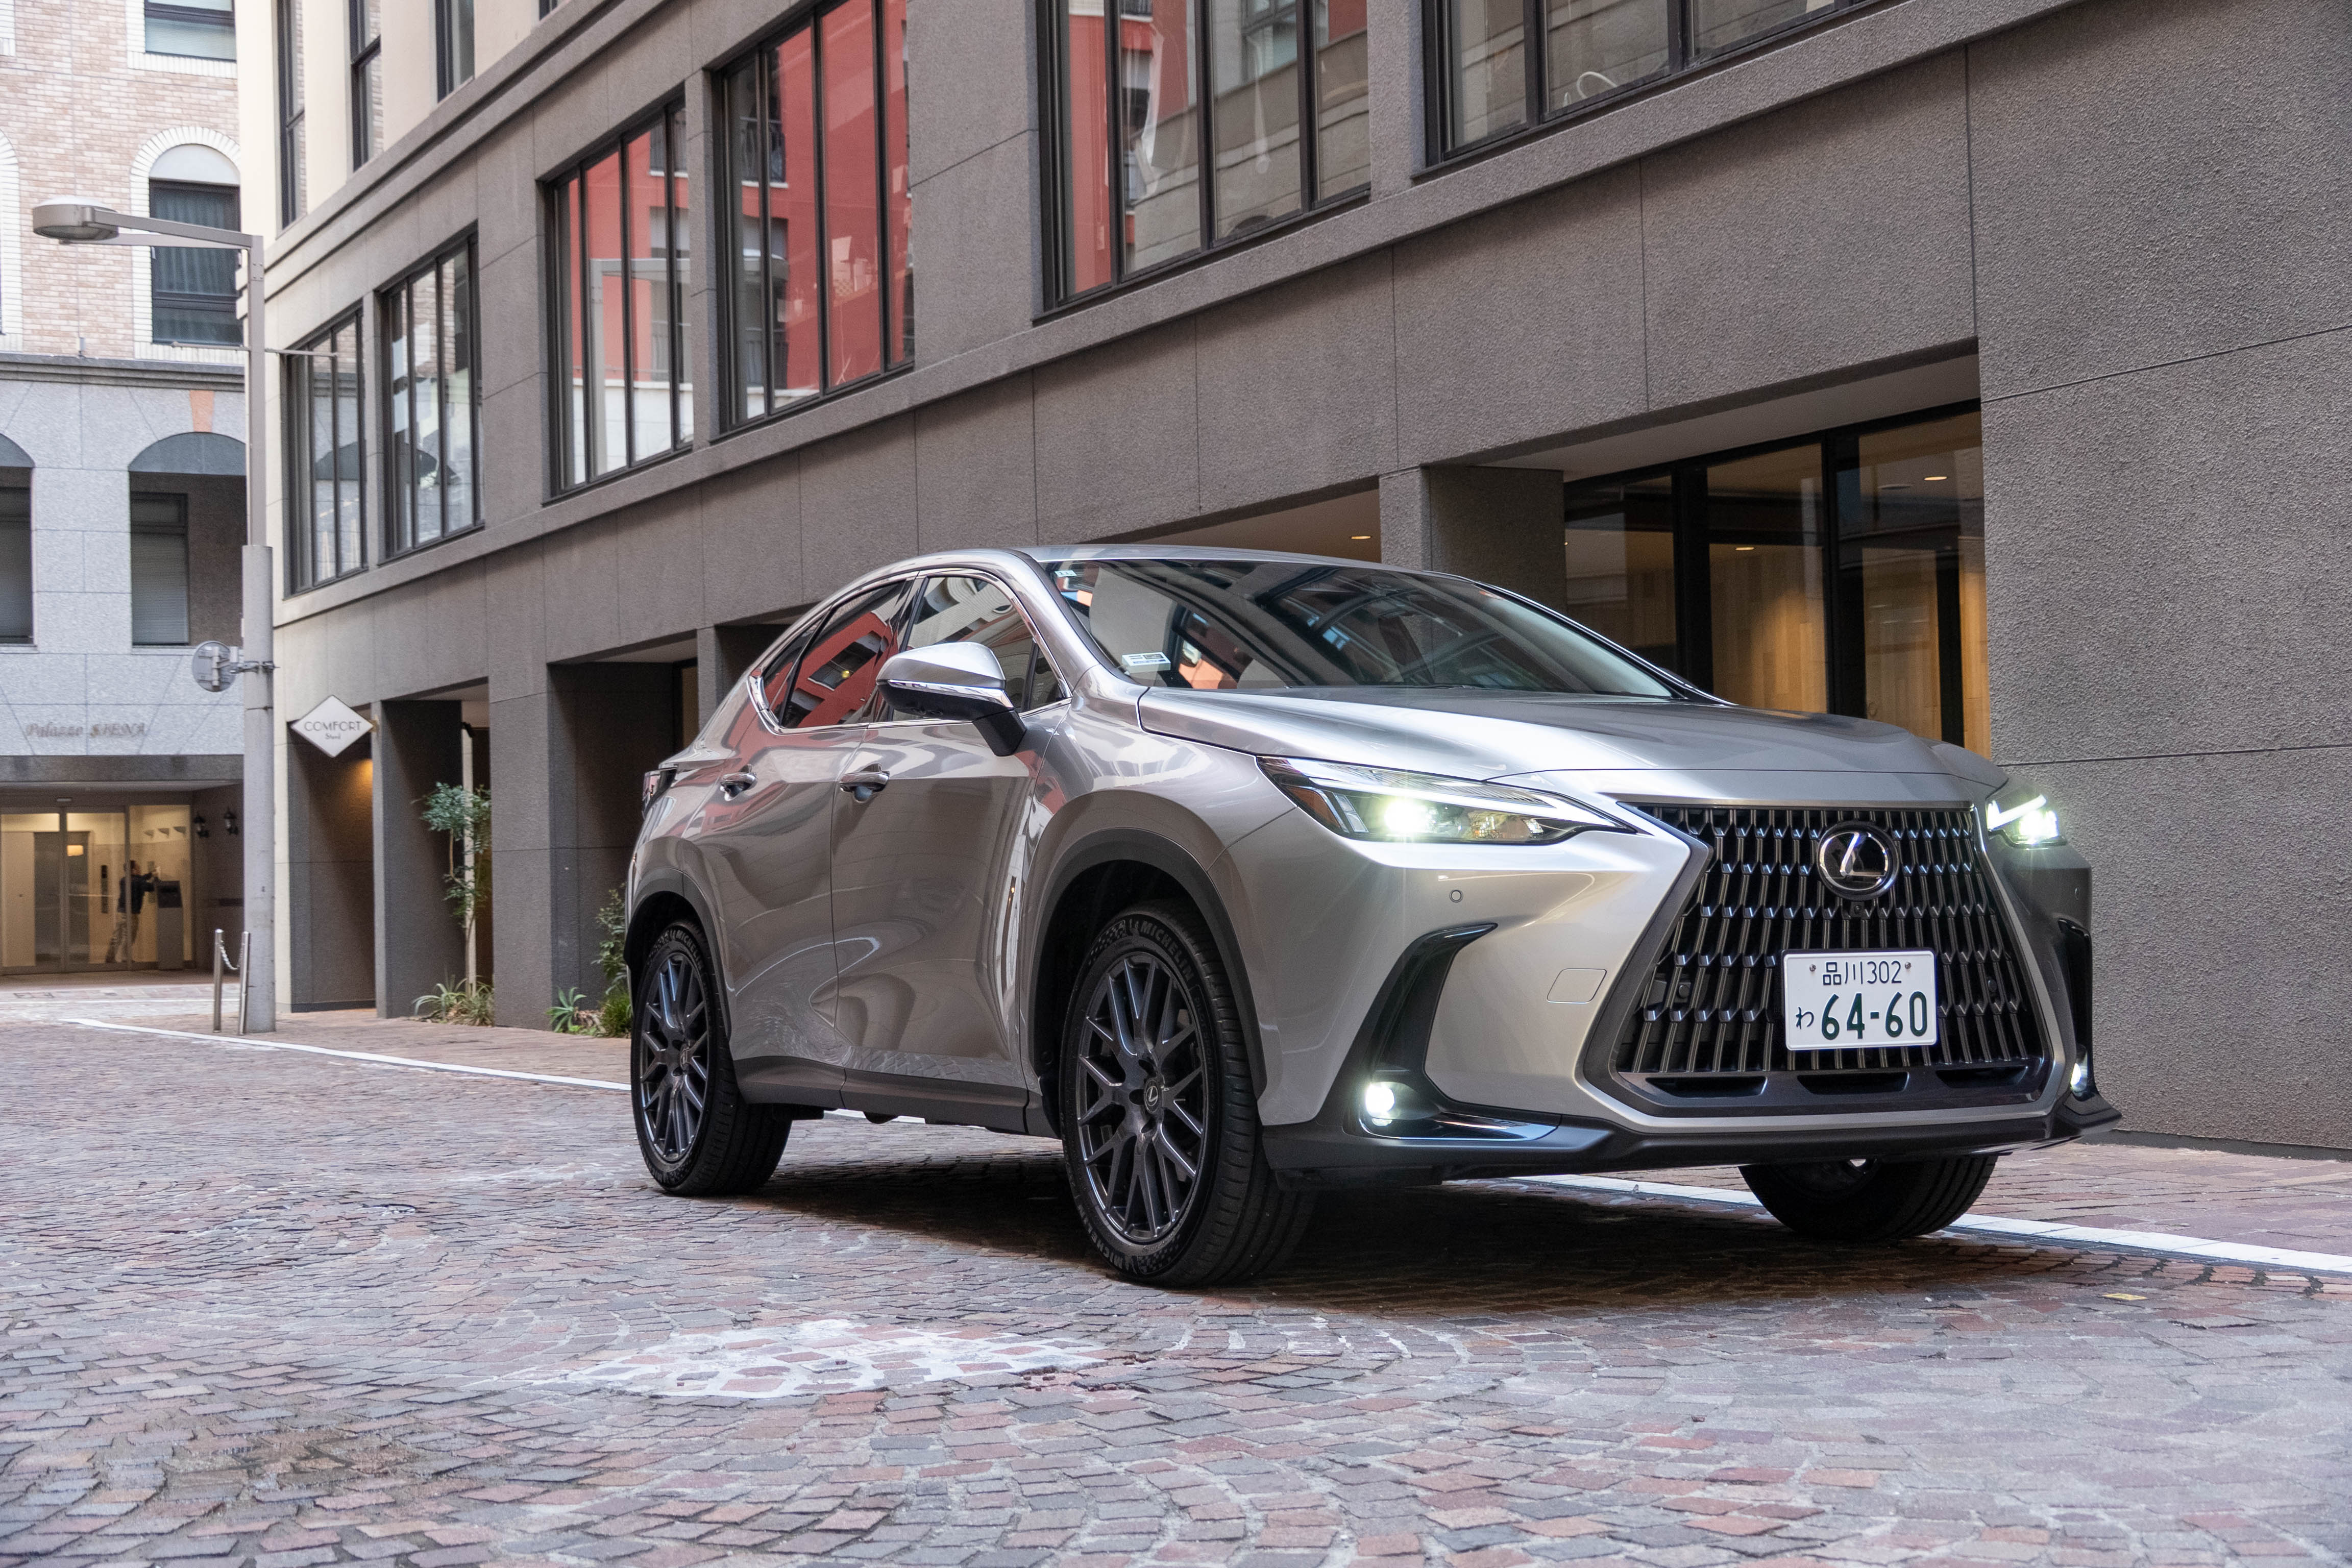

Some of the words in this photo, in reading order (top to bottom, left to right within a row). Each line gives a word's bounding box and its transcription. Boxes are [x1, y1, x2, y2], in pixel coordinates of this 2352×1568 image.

[304, 721, 361, 731] COMFORT
[675, 929, 703, 971] MICHELIN
[1140, 920, 1195, 981] MICHELIN
[1795, 1007, 1815, 1030] わ
[1821, 991, 1928, 1040] 64-60
